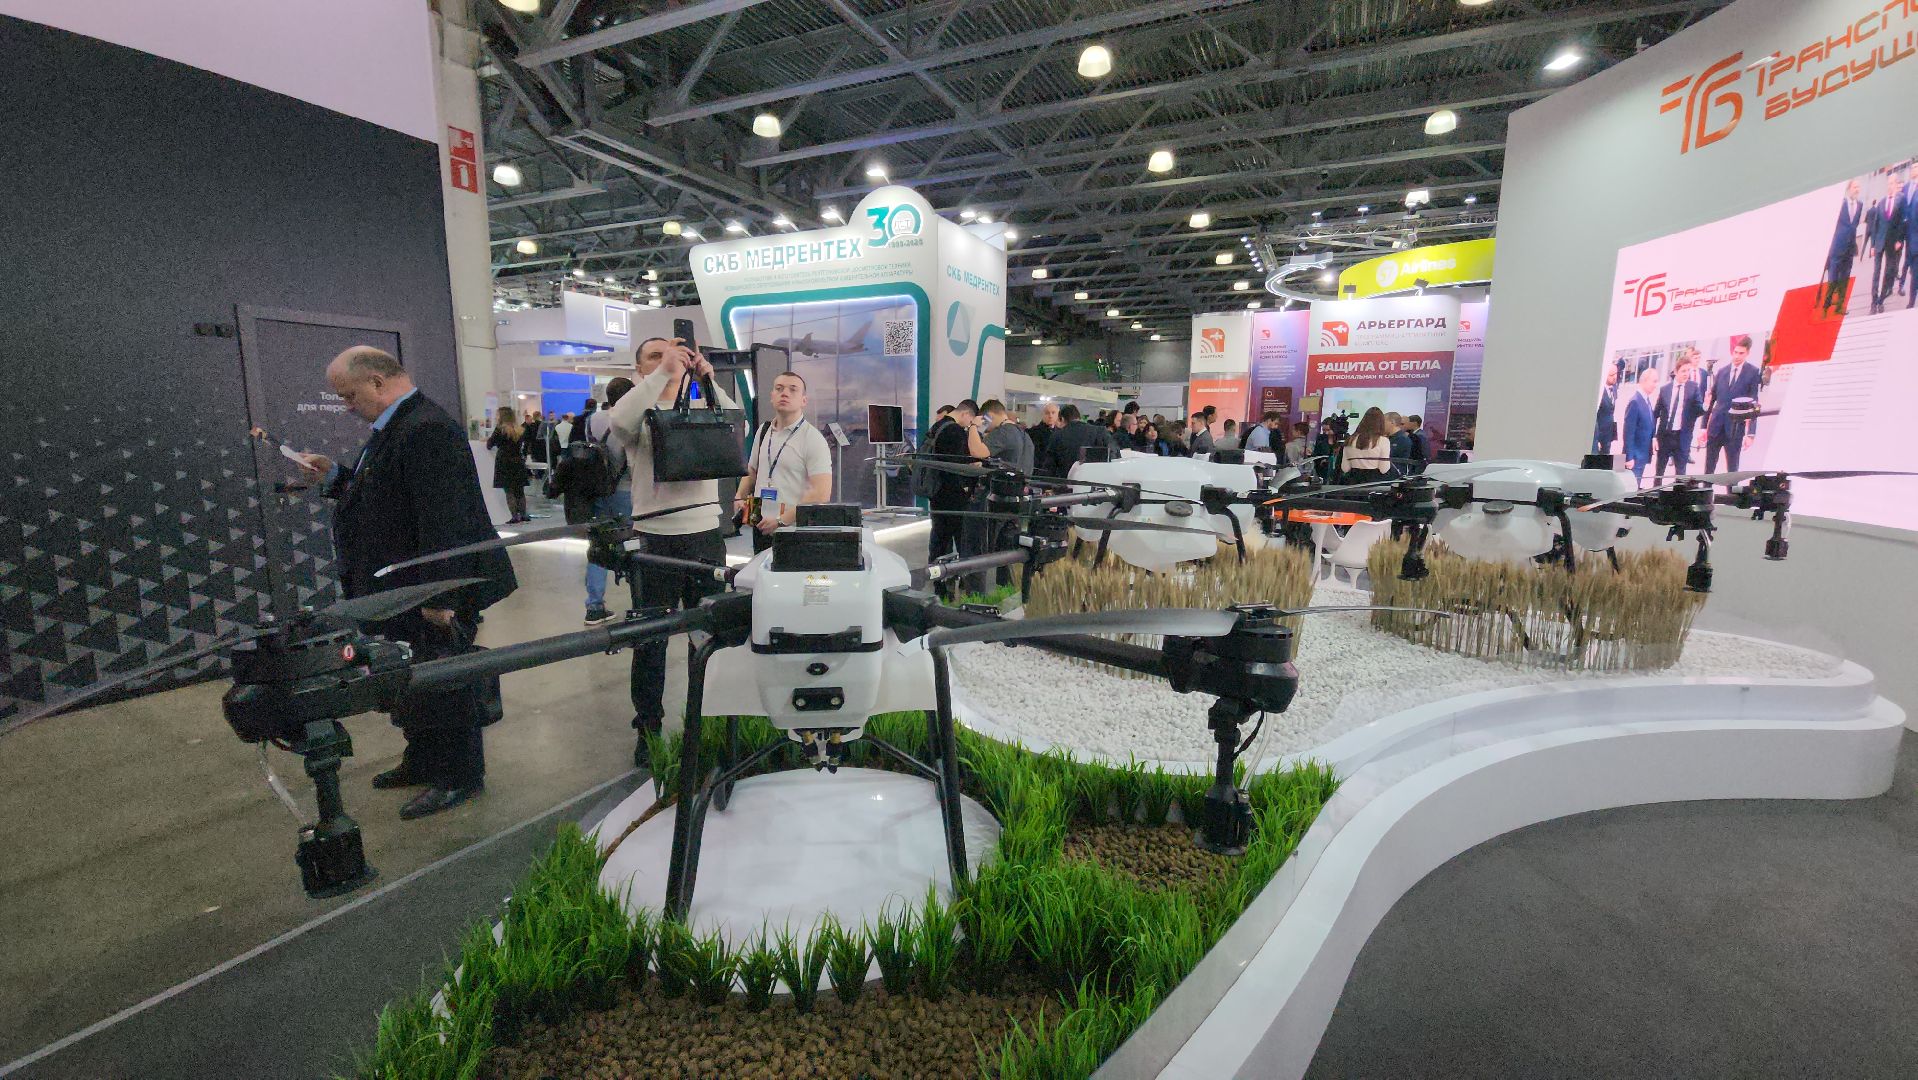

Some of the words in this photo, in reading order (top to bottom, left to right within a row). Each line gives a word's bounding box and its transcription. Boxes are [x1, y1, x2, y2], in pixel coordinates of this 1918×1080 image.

[1764, 30, 1918, 120] БУДУЩ
[866, 203, 922, 247] 30
[703, 252, 740, 273] СКБ
[746, 238, 862, 270] МЕДРЕНТЕХ
[946, 264, 962, 281] СКБ
[963, 269, 1000, 297] МЕДРЕНТЕХ
[1356, 317, 1447, 330] АРЬЕРГАРД
[1316, 361, 1375, 373] ЗАЩИТА
[1378, 361, 1397, 371] ОТ
[1400, 359, 1441, 371] БПЛА
[297, 403, 317, 413] для
